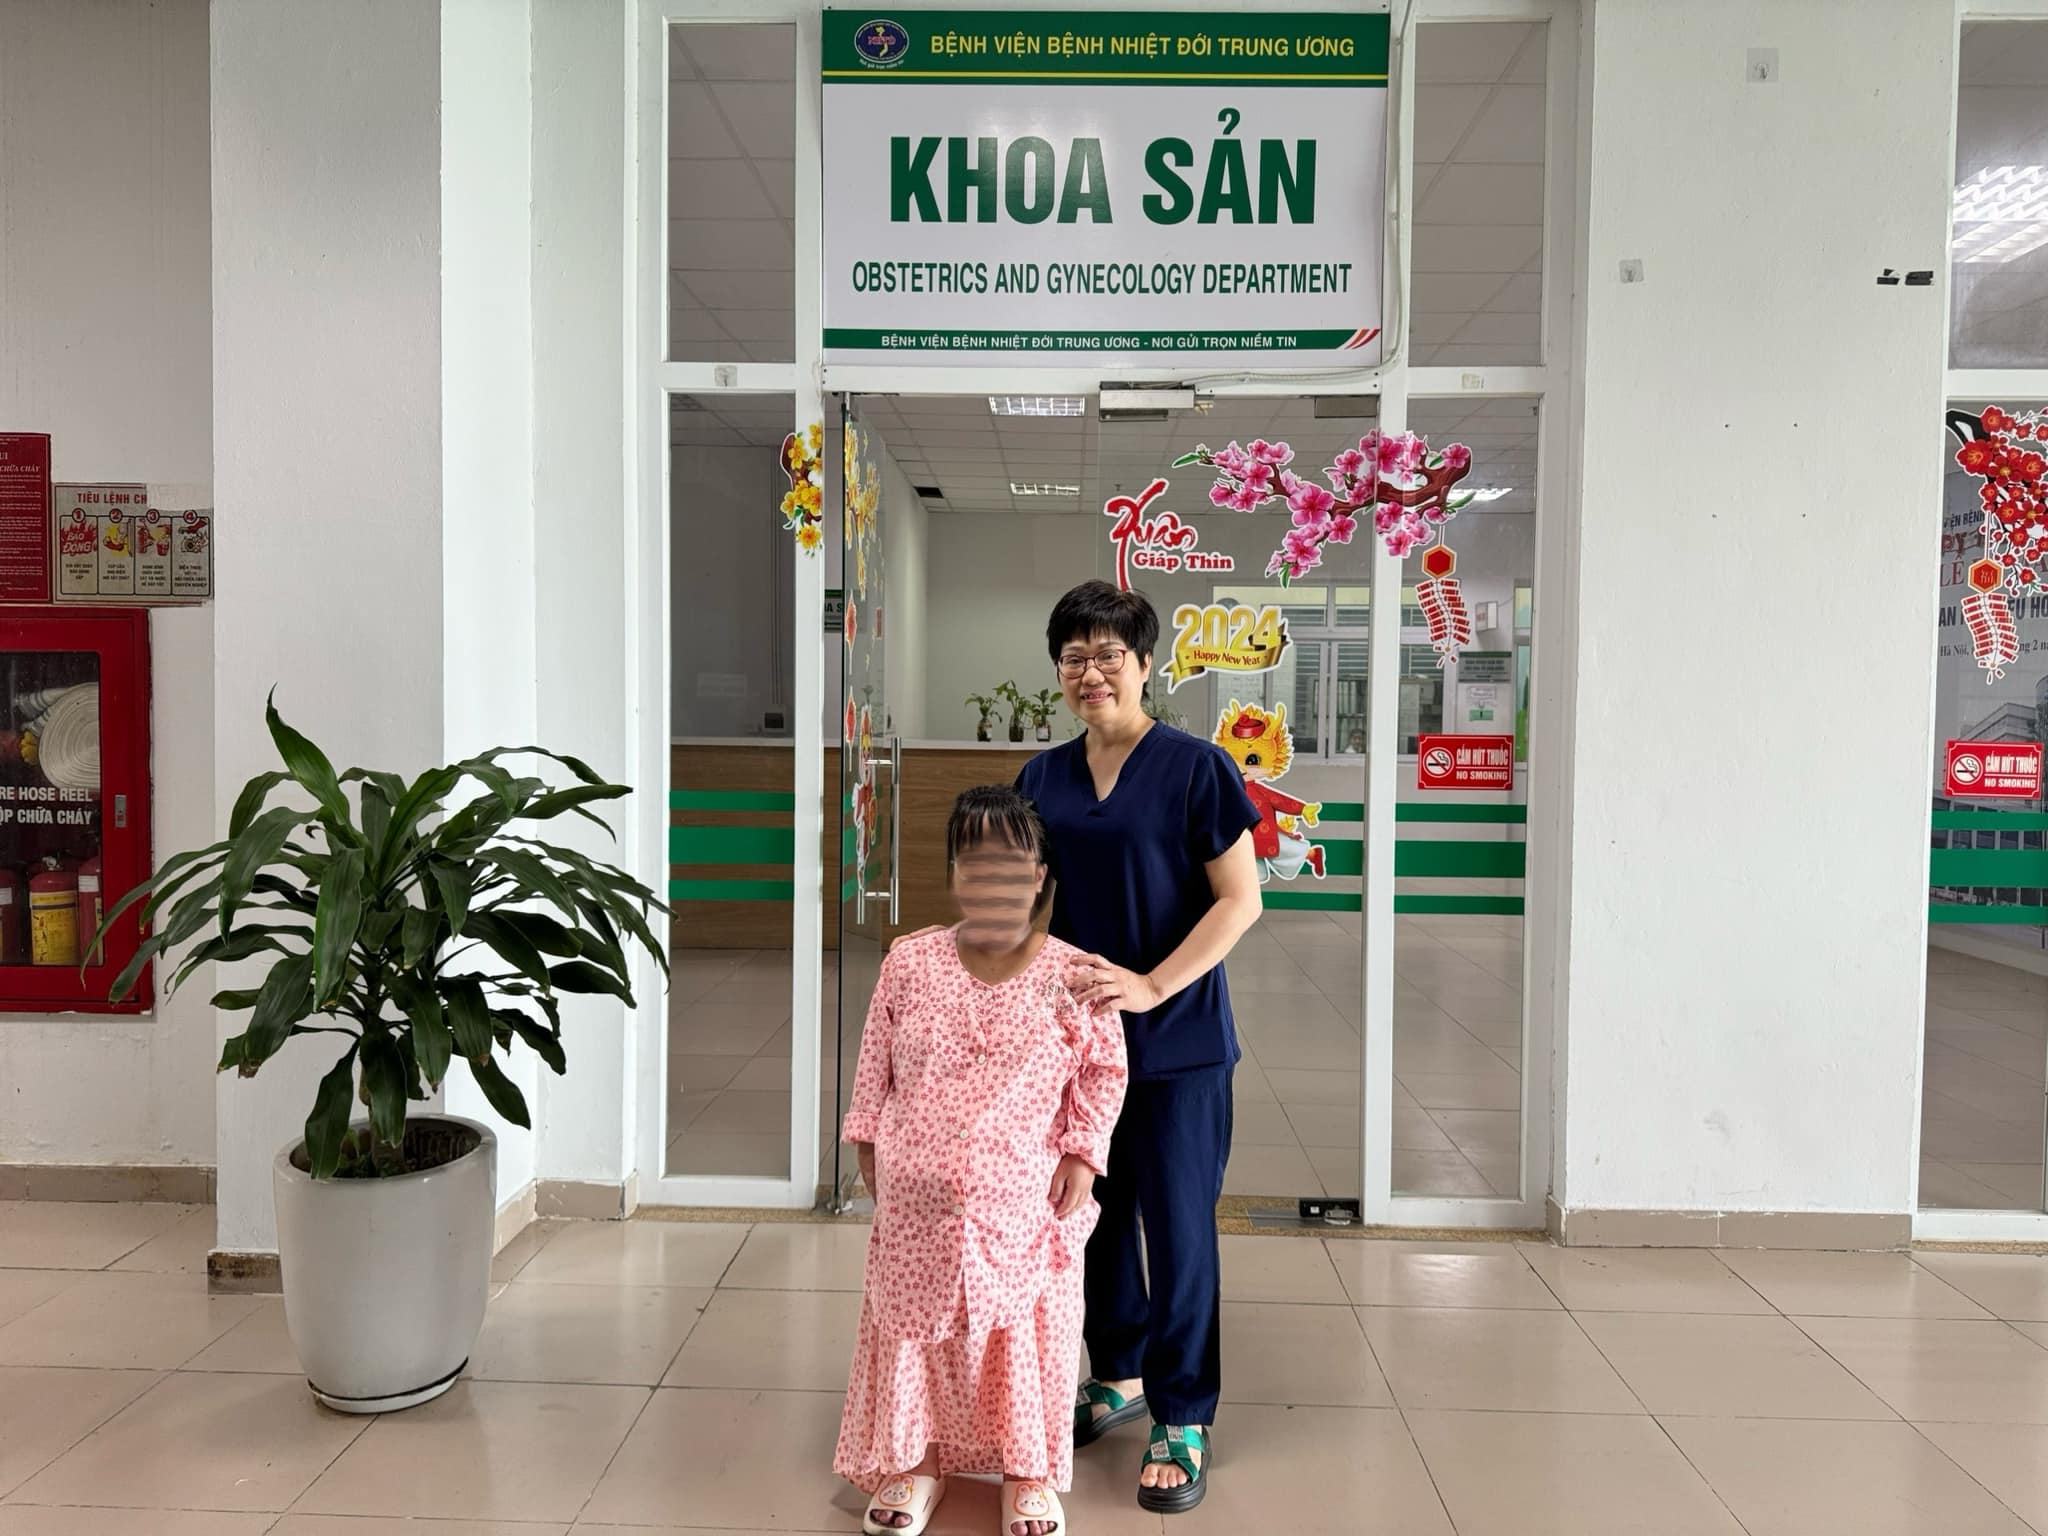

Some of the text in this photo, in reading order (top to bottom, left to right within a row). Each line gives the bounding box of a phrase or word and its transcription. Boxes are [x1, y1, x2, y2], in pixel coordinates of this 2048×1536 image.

[931, 31, 1355, 59] BỆNH VIỆN BỆNH NHIỆT ĐỚI TRUNG ƯƠNG
[890, 107, 1317, 226] KHOA SẢN
[852, 260, 1353, 295] OBSTETRICS AND GYNECOLOGY DEPARTMENT
[881, 333, 917, 349] BỆNH
[920, 333, 949, 350] VIỆN
[952, 334, 987, 350] BỆNH
[991, 334, 1028, 350] NHIỆT
[1031, 335, 1054, 349] ĐỚI
[1057, 336, 1101, 349] TRUNG
[1104, 335, 1140, 348] ƯƠNG
[1152, 335, 1173, 348] NƠI
[1176, 333, 1199, 348] GỬI
[1202, 336, 1237, 350] TRỌN
[1276, 335, 1297, 348] TIN
[77, 491, 100, 505] TIÊU
[103, 491, 130, 507] LỆNH
[1133, 552, 1180, 571] Giáp
[1176, 606, 1281, 652] 2024
[1193, 649, 1261, 666] Happy New Year
[1456, 770, 1508, 780] NO SMOKING
[1984, 777, 2037, 789] NO SMOKING
[19, 786, 56, 801] HOSE
[60, 788, 93, 802] REEL
[17, 806, 53, 824] CHỮA
[57, 807, 92, 825] CHÁY
